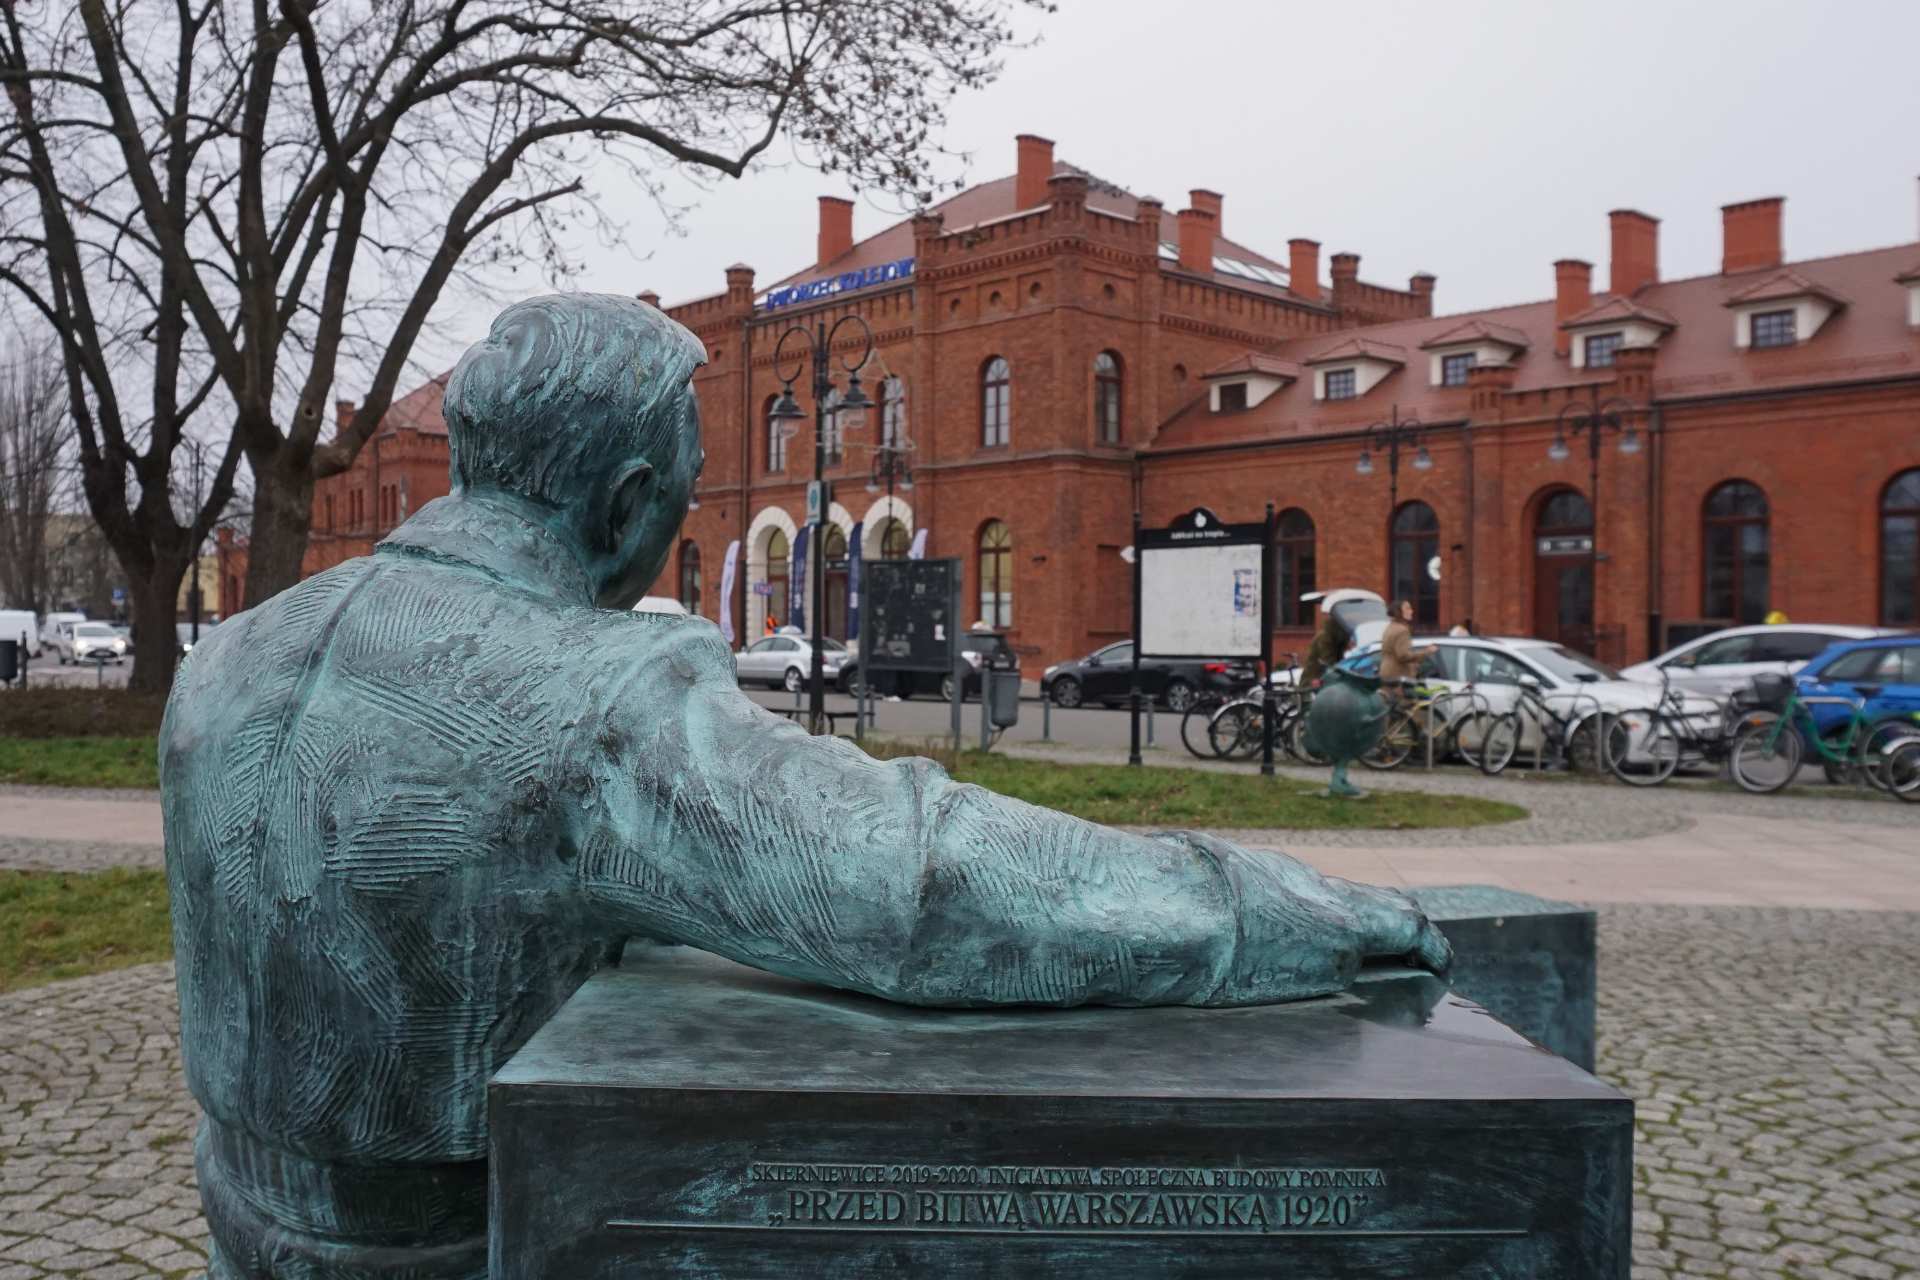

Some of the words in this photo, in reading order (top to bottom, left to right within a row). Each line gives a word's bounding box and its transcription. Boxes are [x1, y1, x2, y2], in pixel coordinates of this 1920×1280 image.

[752, 1163, 887, 1183] SKIERNIEWICE
[1099, 1167, 1206, 1187] SPOŁECZNA
[1212, 1168, 1293, 1188] BUDOWY
[1300, 1169, 1385, 1187] POMNIKA
[916, 1191, 1026, 1231] BITWĄ
[1036, 1193, 1269, 1234] WARSZAWSKĄ
